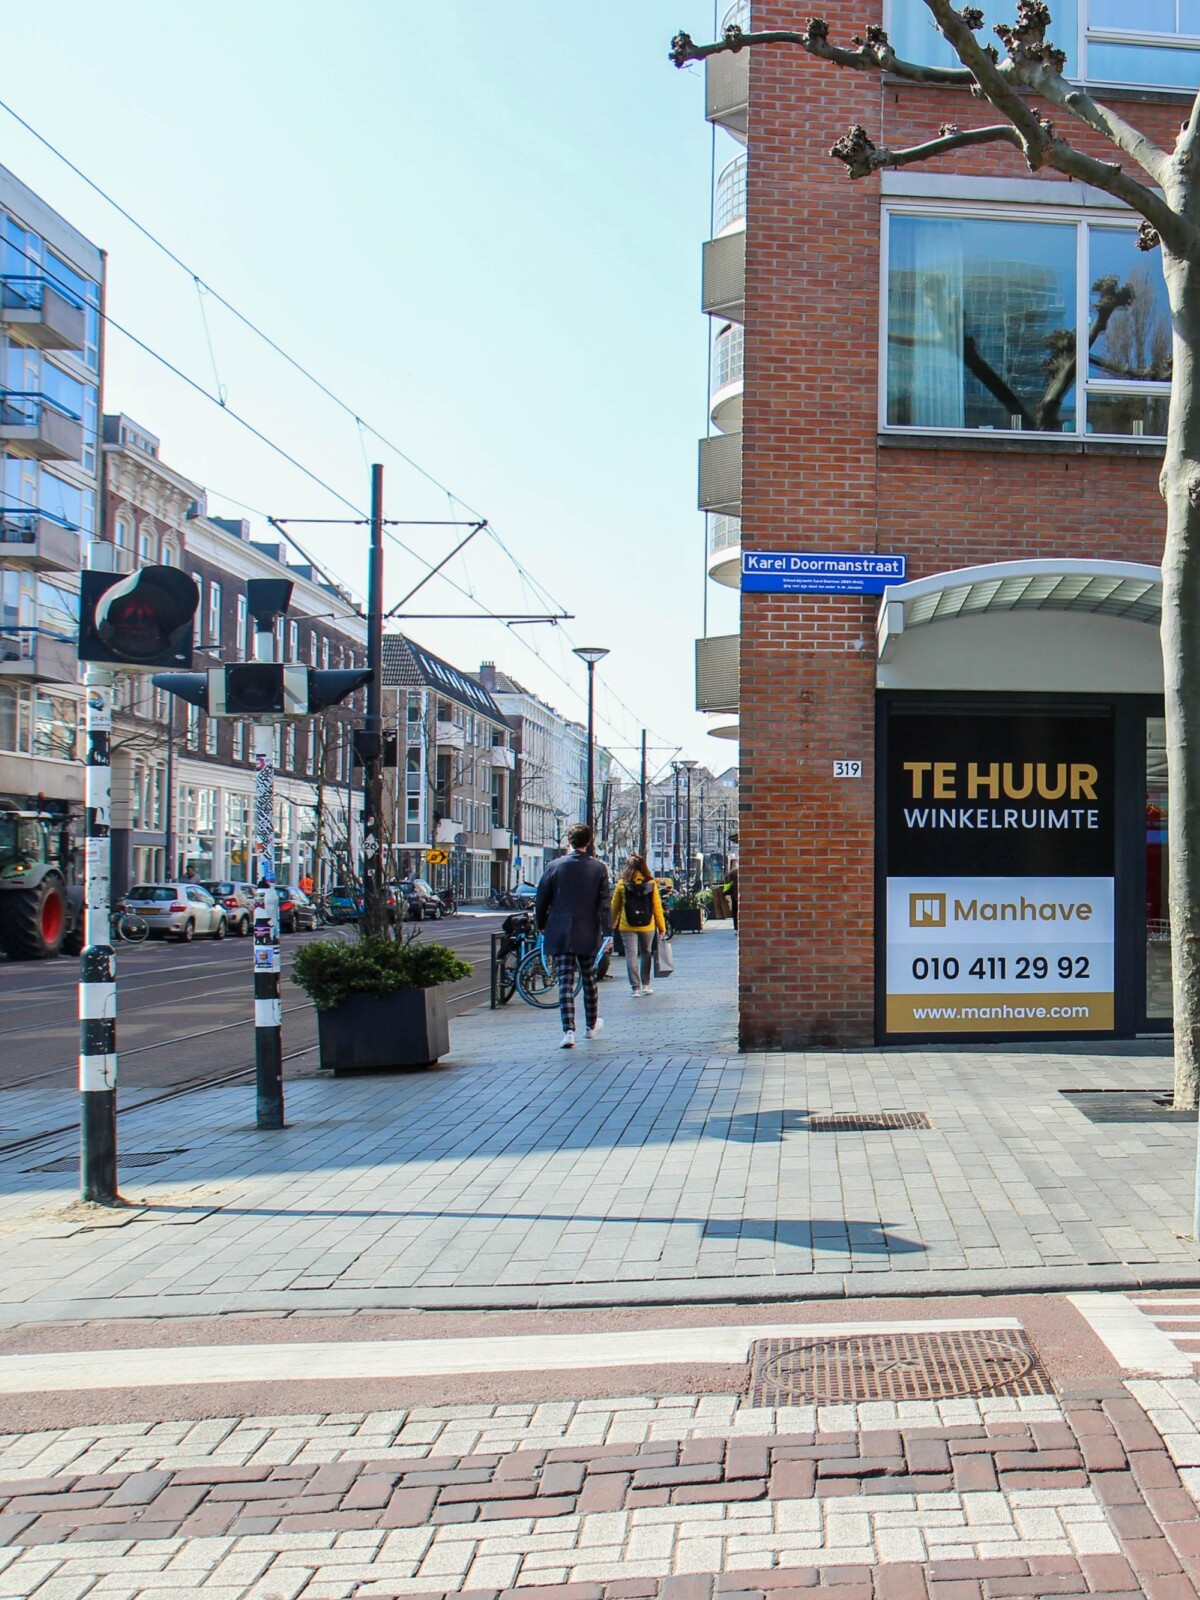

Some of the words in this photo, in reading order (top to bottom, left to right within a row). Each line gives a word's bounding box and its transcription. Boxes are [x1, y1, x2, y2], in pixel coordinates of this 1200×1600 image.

[748, 556, 786, 570] Karel
[790, 558, 899, 573] Doormanstraat
[835, 762, 860, 776] 319
[903, 762, 957, 799] TE
[967, 762, 1099, 800] HUUR
[903, 808, 1099, 829] WINKELRUIMTE
[954, 896, 1093, 921] Manhave
[912, 957, 960, 980] 010
[968, 957, 1006, 980] 411
[1015, 956, 1048, 980] 29
[1057, 956, 1090, 979] 92
[912, 1003, 1089, 1019] www.manhave.com
